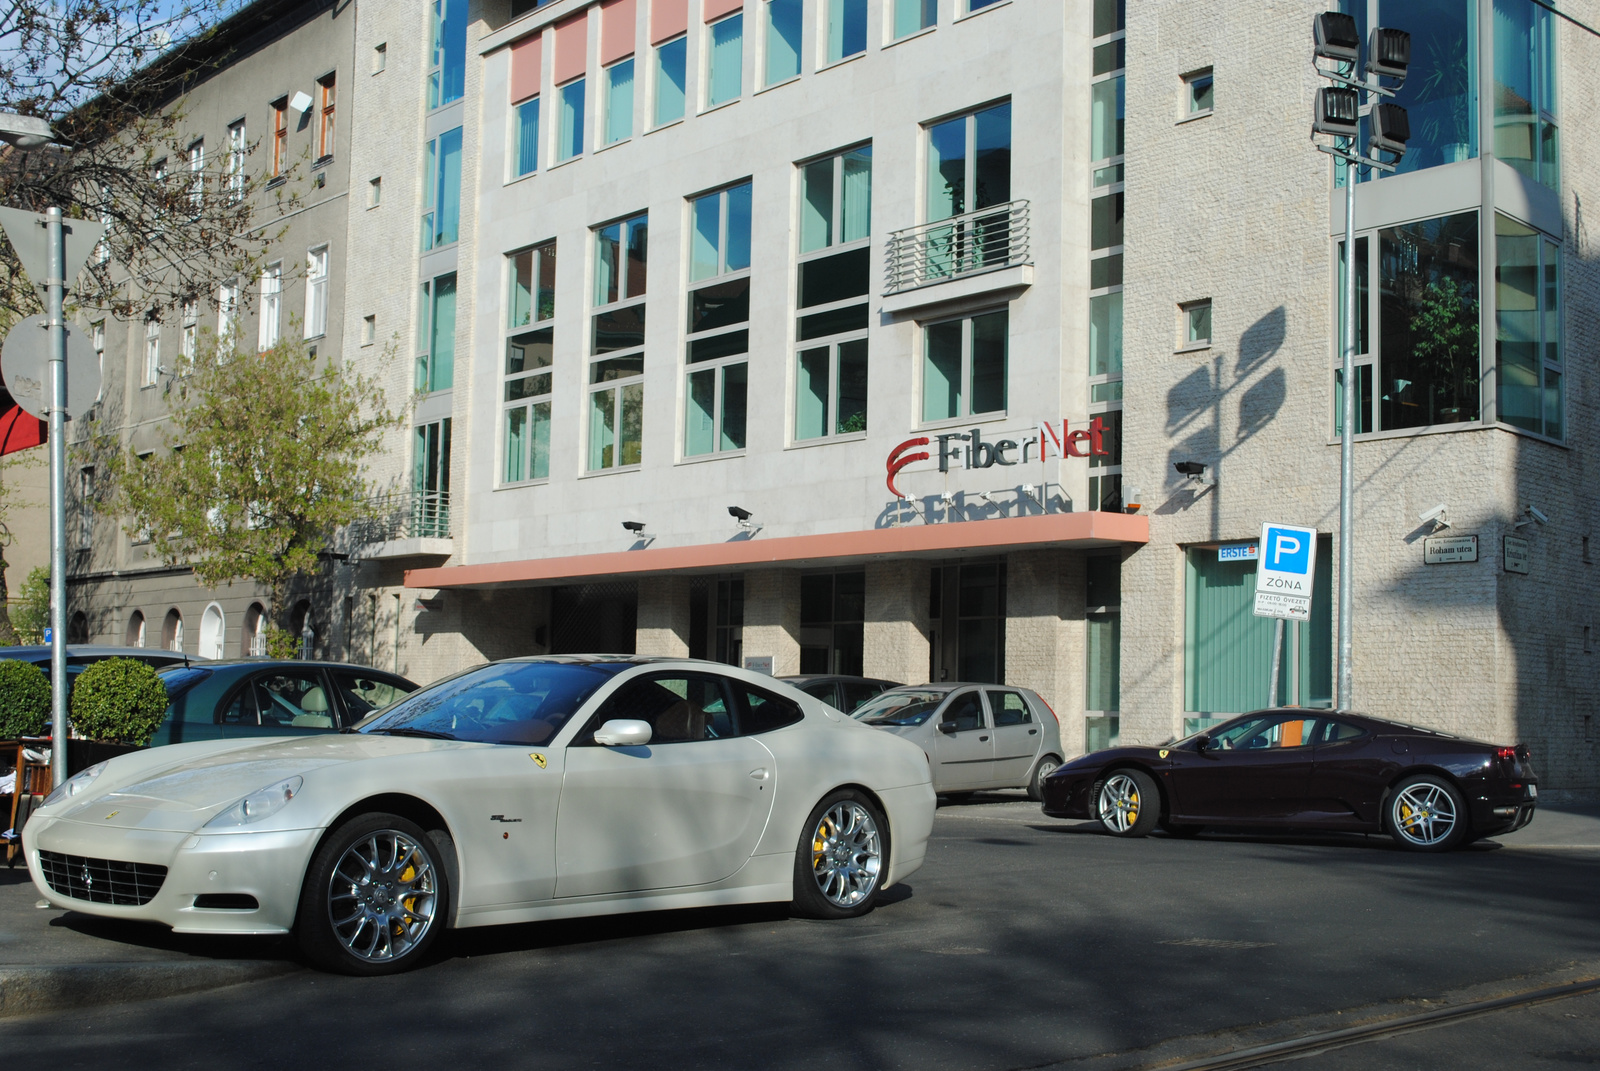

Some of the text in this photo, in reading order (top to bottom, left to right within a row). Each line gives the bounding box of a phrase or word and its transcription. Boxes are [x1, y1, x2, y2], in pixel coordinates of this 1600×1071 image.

[935, 417, 1110, 473] FiberNet
[1221, 547, 1247, 558] ERSTE
[1274, 535, 1300, 564] P
[1430, 546, 1455, 555] Roham
[1266, 576, 1302, 590] ZÓNA
